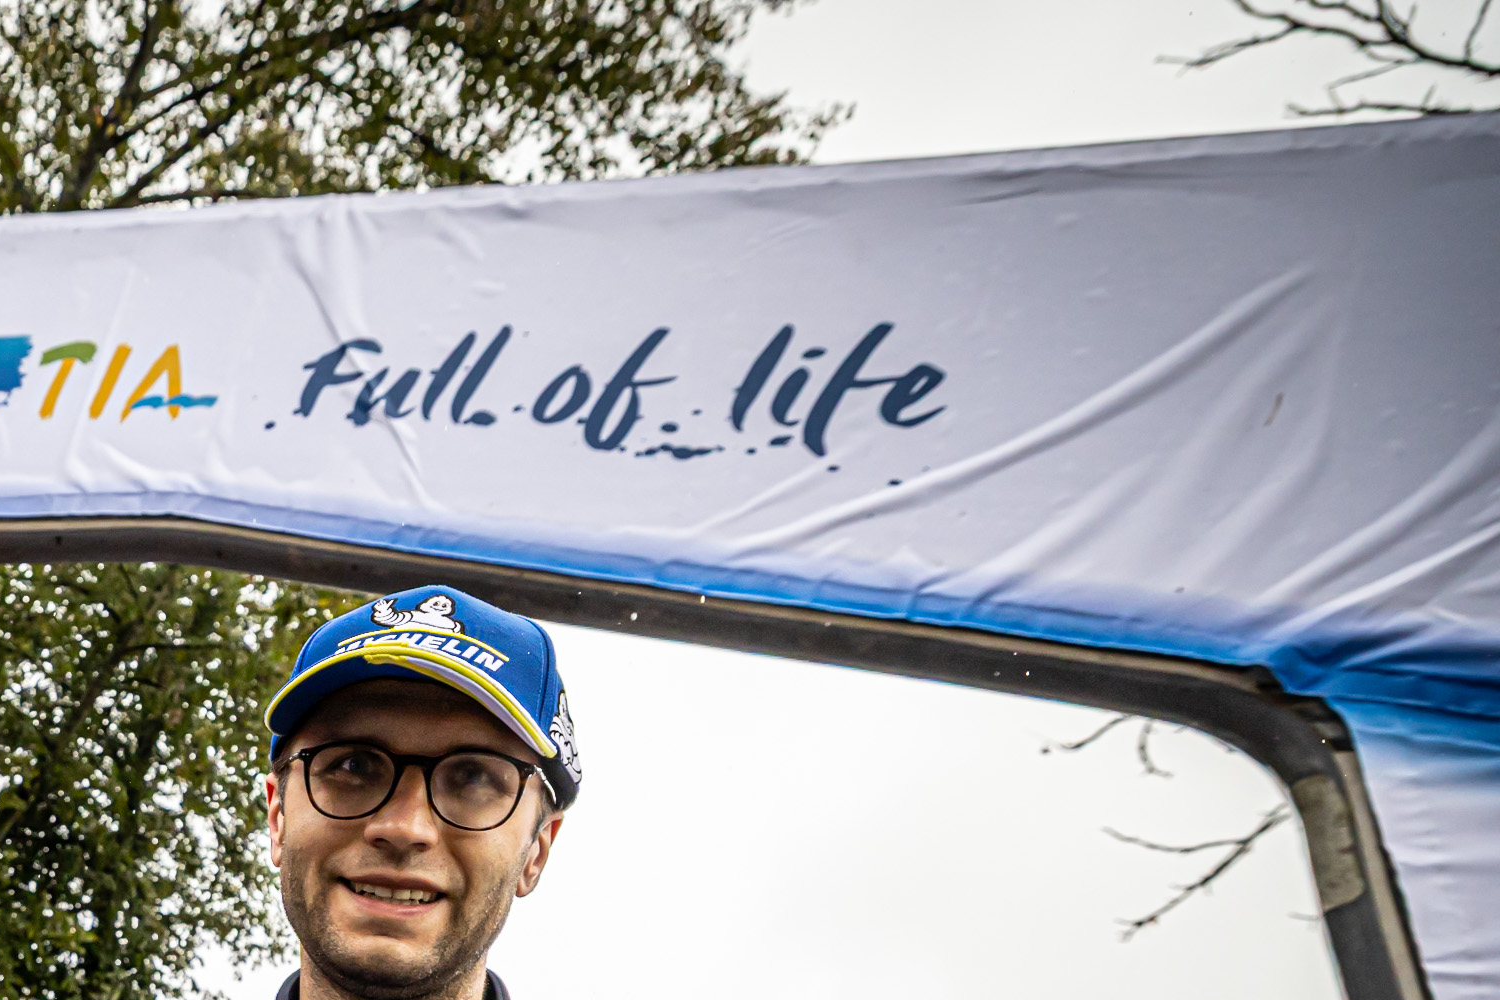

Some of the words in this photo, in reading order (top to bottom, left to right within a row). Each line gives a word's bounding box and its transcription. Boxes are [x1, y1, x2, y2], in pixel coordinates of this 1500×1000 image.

[299, 324, 512, 426] Full
[531, 327, 678, 450] of
[731, 322, 947, 457] life
